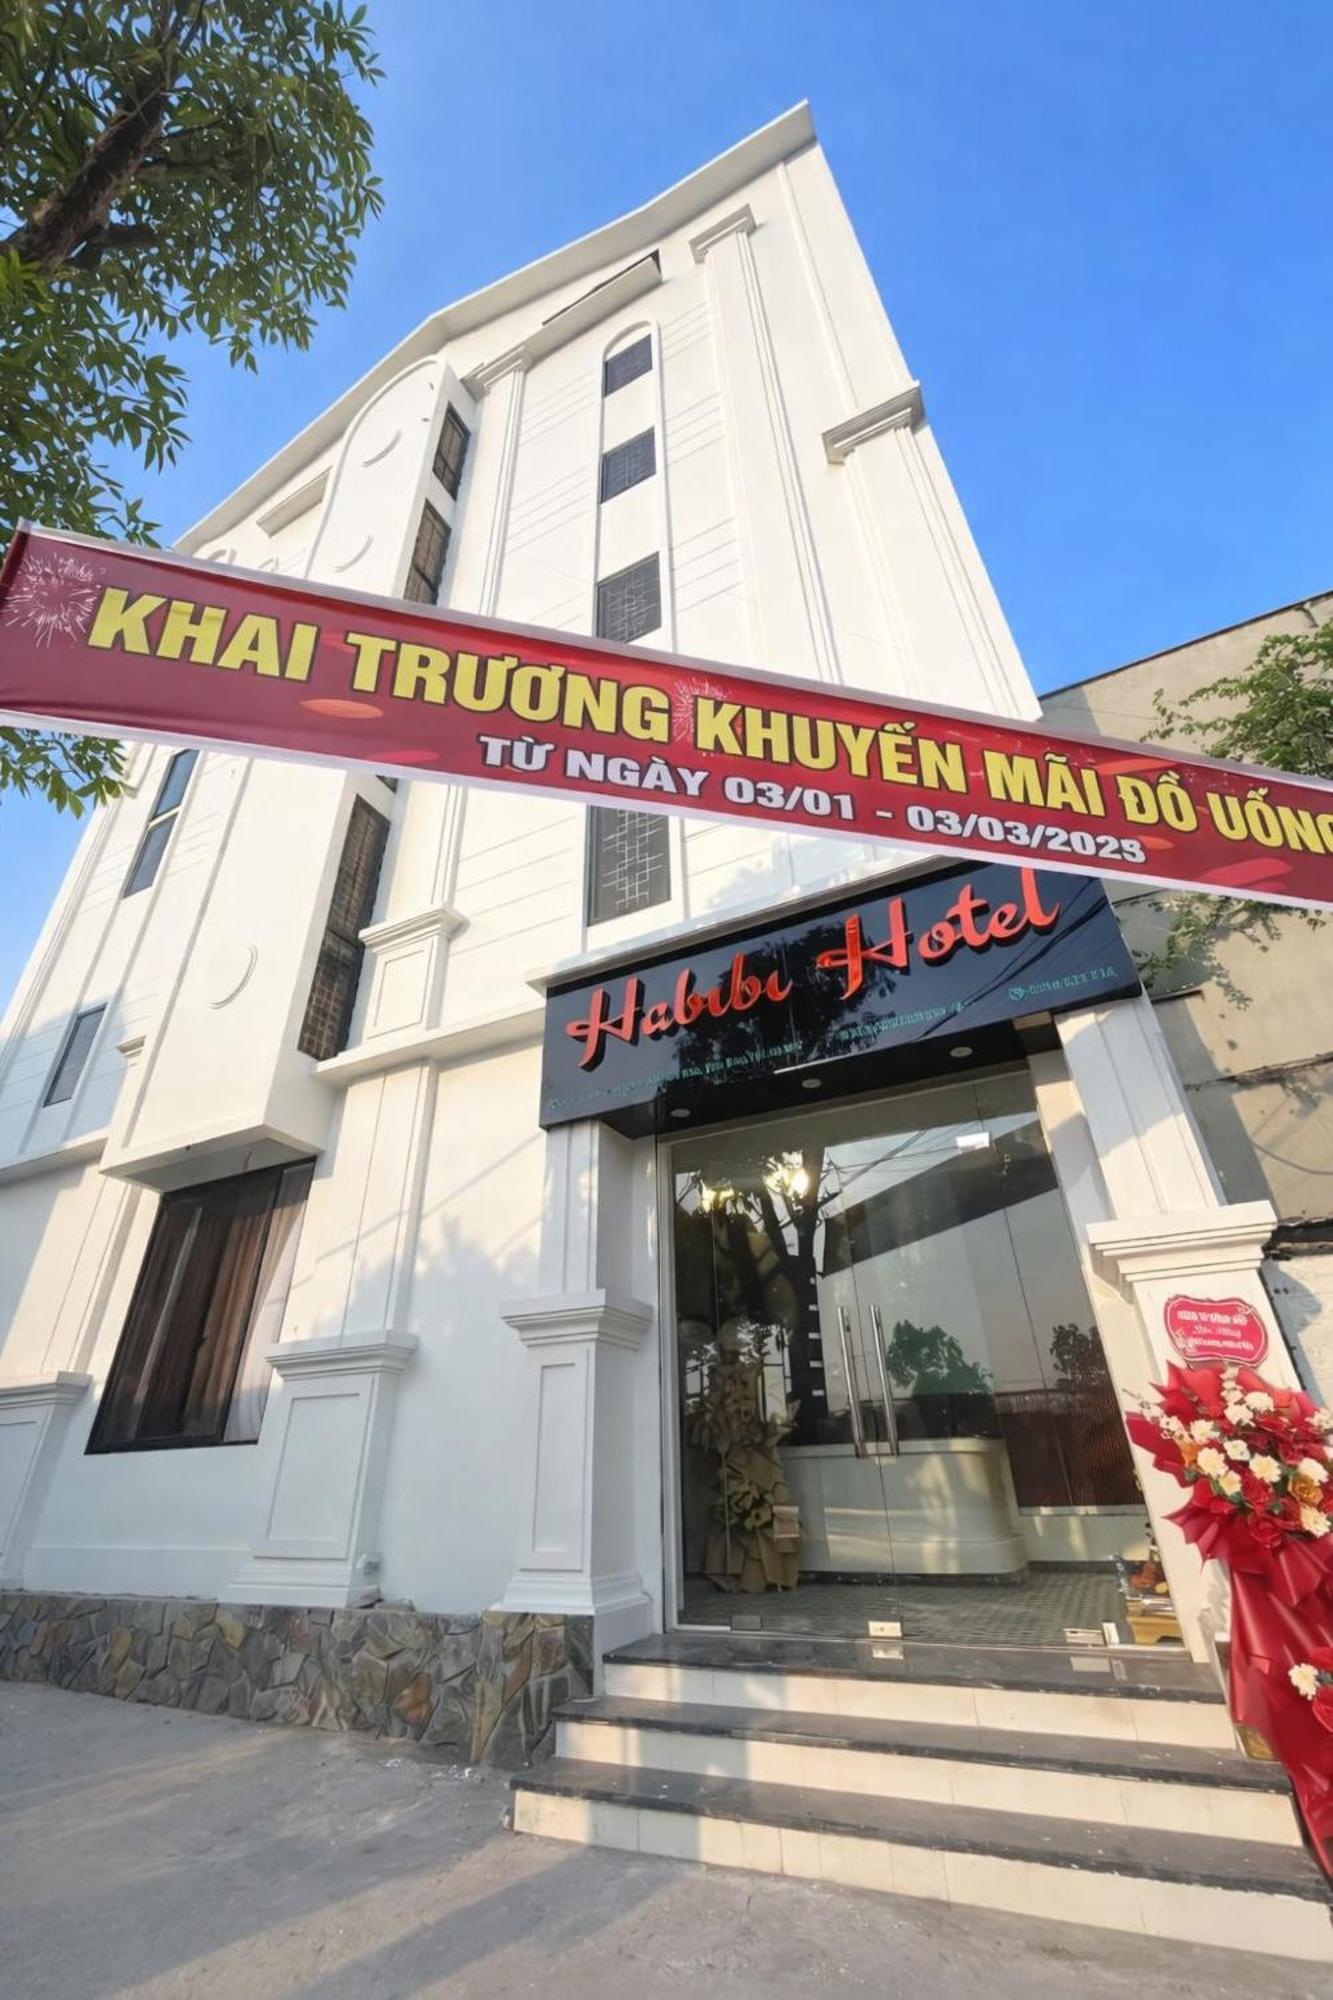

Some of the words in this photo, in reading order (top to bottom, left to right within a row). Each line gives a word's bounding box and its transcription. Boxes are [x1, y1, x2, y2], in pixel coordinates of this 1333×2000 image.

[88, 587, 319, 682] KHAI
[346, 632, 671, 743] TRƯƠNG
[696, 697, 968, 793] KHUYẾN
[983, 750, 1106, 817] MÃI
[1116, 770, 1198, 832] ĐỒ
[480, 735, 555, 772] TỪ
[565, 749, 709, 797] NGÀY
[724, 776, 854, 820] 03/01
[565, 952, 794, 1068] Habibi
[816, 866, 1060, 1000] Hotel
